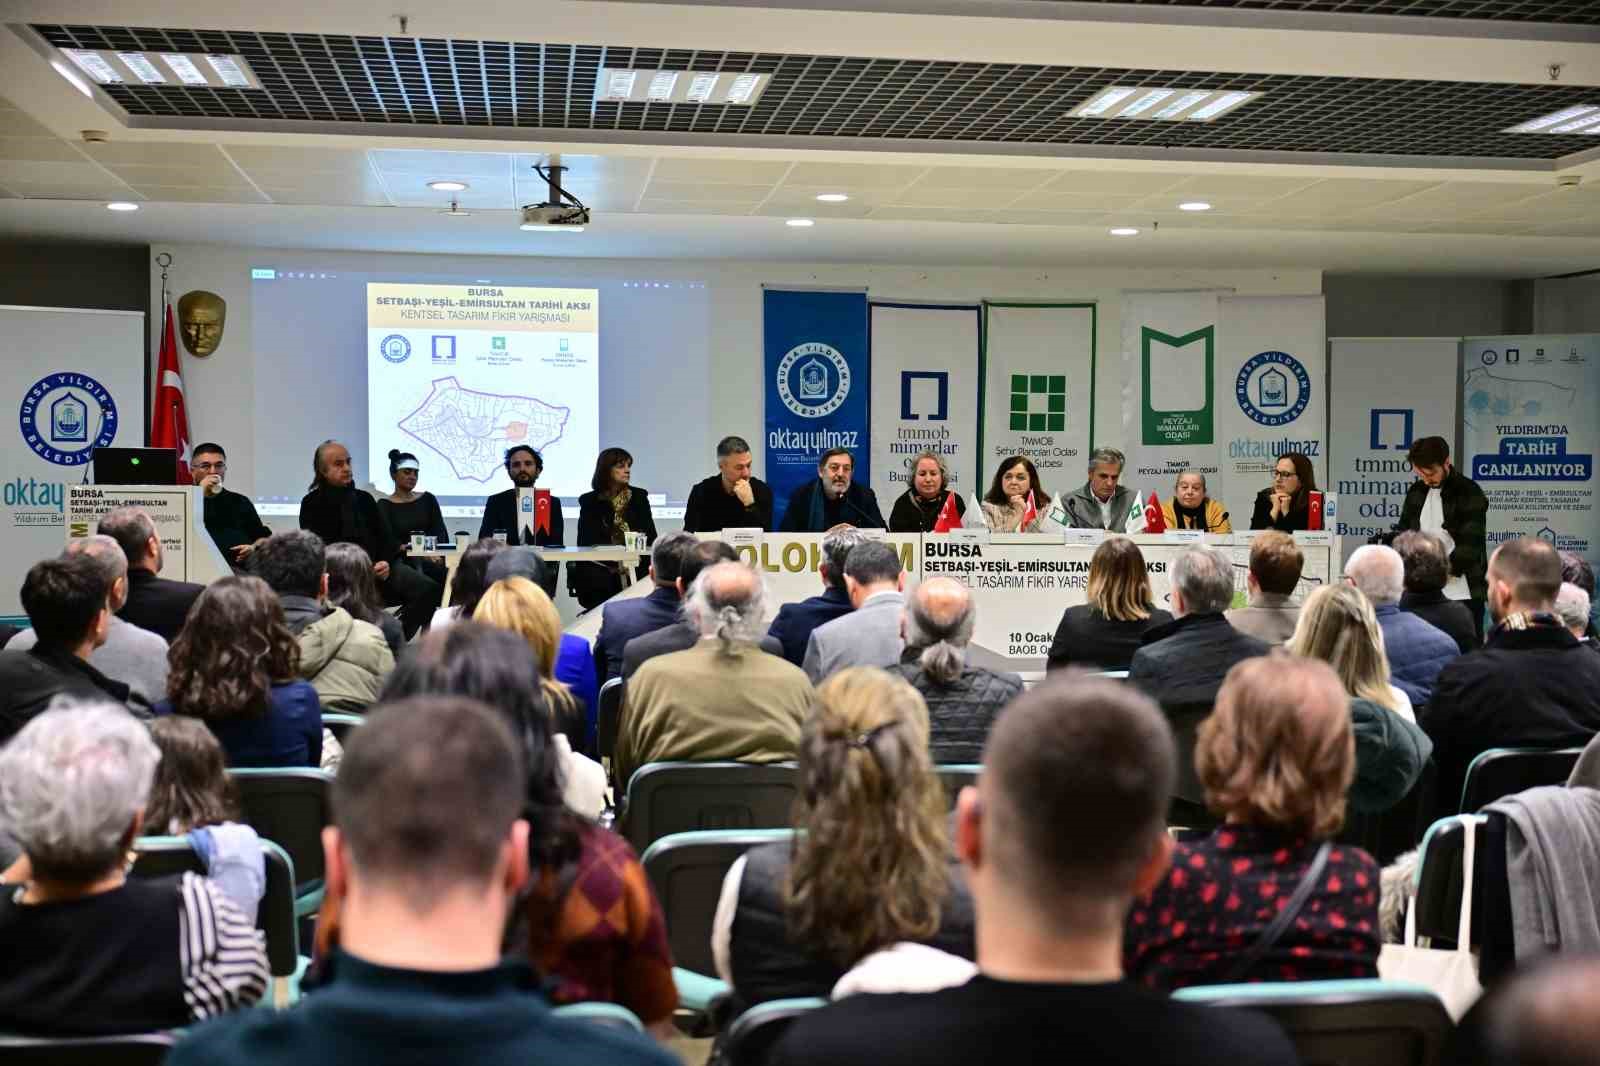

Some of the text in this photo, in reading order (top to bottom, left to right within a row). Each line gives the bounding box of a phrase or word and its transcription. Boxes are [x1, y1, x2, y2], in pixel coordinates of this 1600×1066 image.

[468, 288, 504, 297] BURSA
[566, 302, 592, 311] AKSI
[400, 309, 446, 321] KENTSEL
[448, 311, 490, 321] TASARIM
[897, 424, 950, 440] tmmob
[1496, 424, 1569, 435] YILDIRIM'DA
[889, 440, 958, 454] mimarlar
[1021, 436, 1055, 446] TMMOB
[1506, 440, 1558, 455] TARİH
[1355, 457, 1414, 473] tmmo
[1478, 464, 1585, 476] CANLANIYOR
[71, 490, 103, 498] BURSA
[1359, 498, 1401, 518] oda
[1336, 523, 1384, 536] Bursa
[925, 543, 982, 557] BURSA
[925, 558, 1166, 575] SETBAŞI-YEŞİL-EMİRSULTAN KSI
[977, 575, 1024, 588] TASARIM
[1009, 633, 1053, 643] 10 Ocak
[1009, 644, 1037, 655] BAOB
